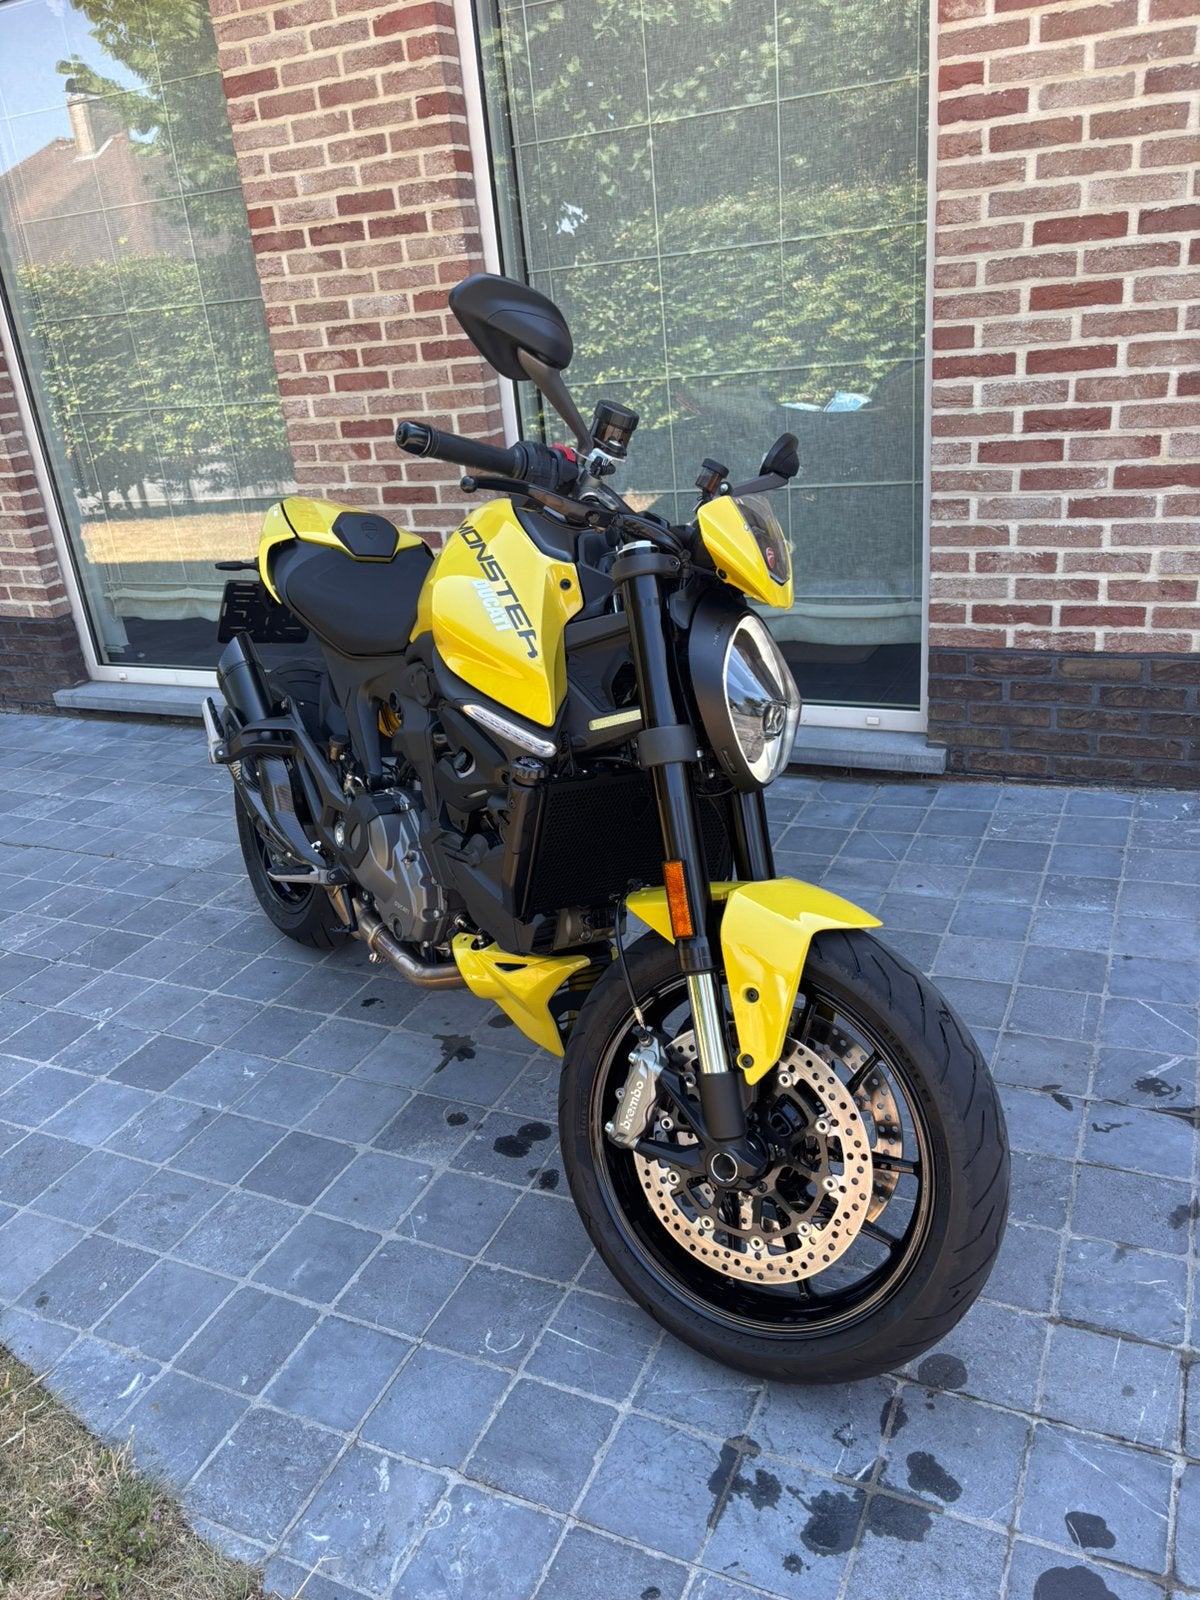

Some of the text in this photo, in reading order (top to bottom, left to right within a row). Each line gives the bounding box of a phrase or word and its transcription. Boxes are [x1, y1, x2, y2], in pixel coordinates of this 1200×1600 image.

[458, 520, 538, 659] MONSTER
[471, 579, 511, 631] DUCATI
[620, 1081, 644, 1131] brembo
